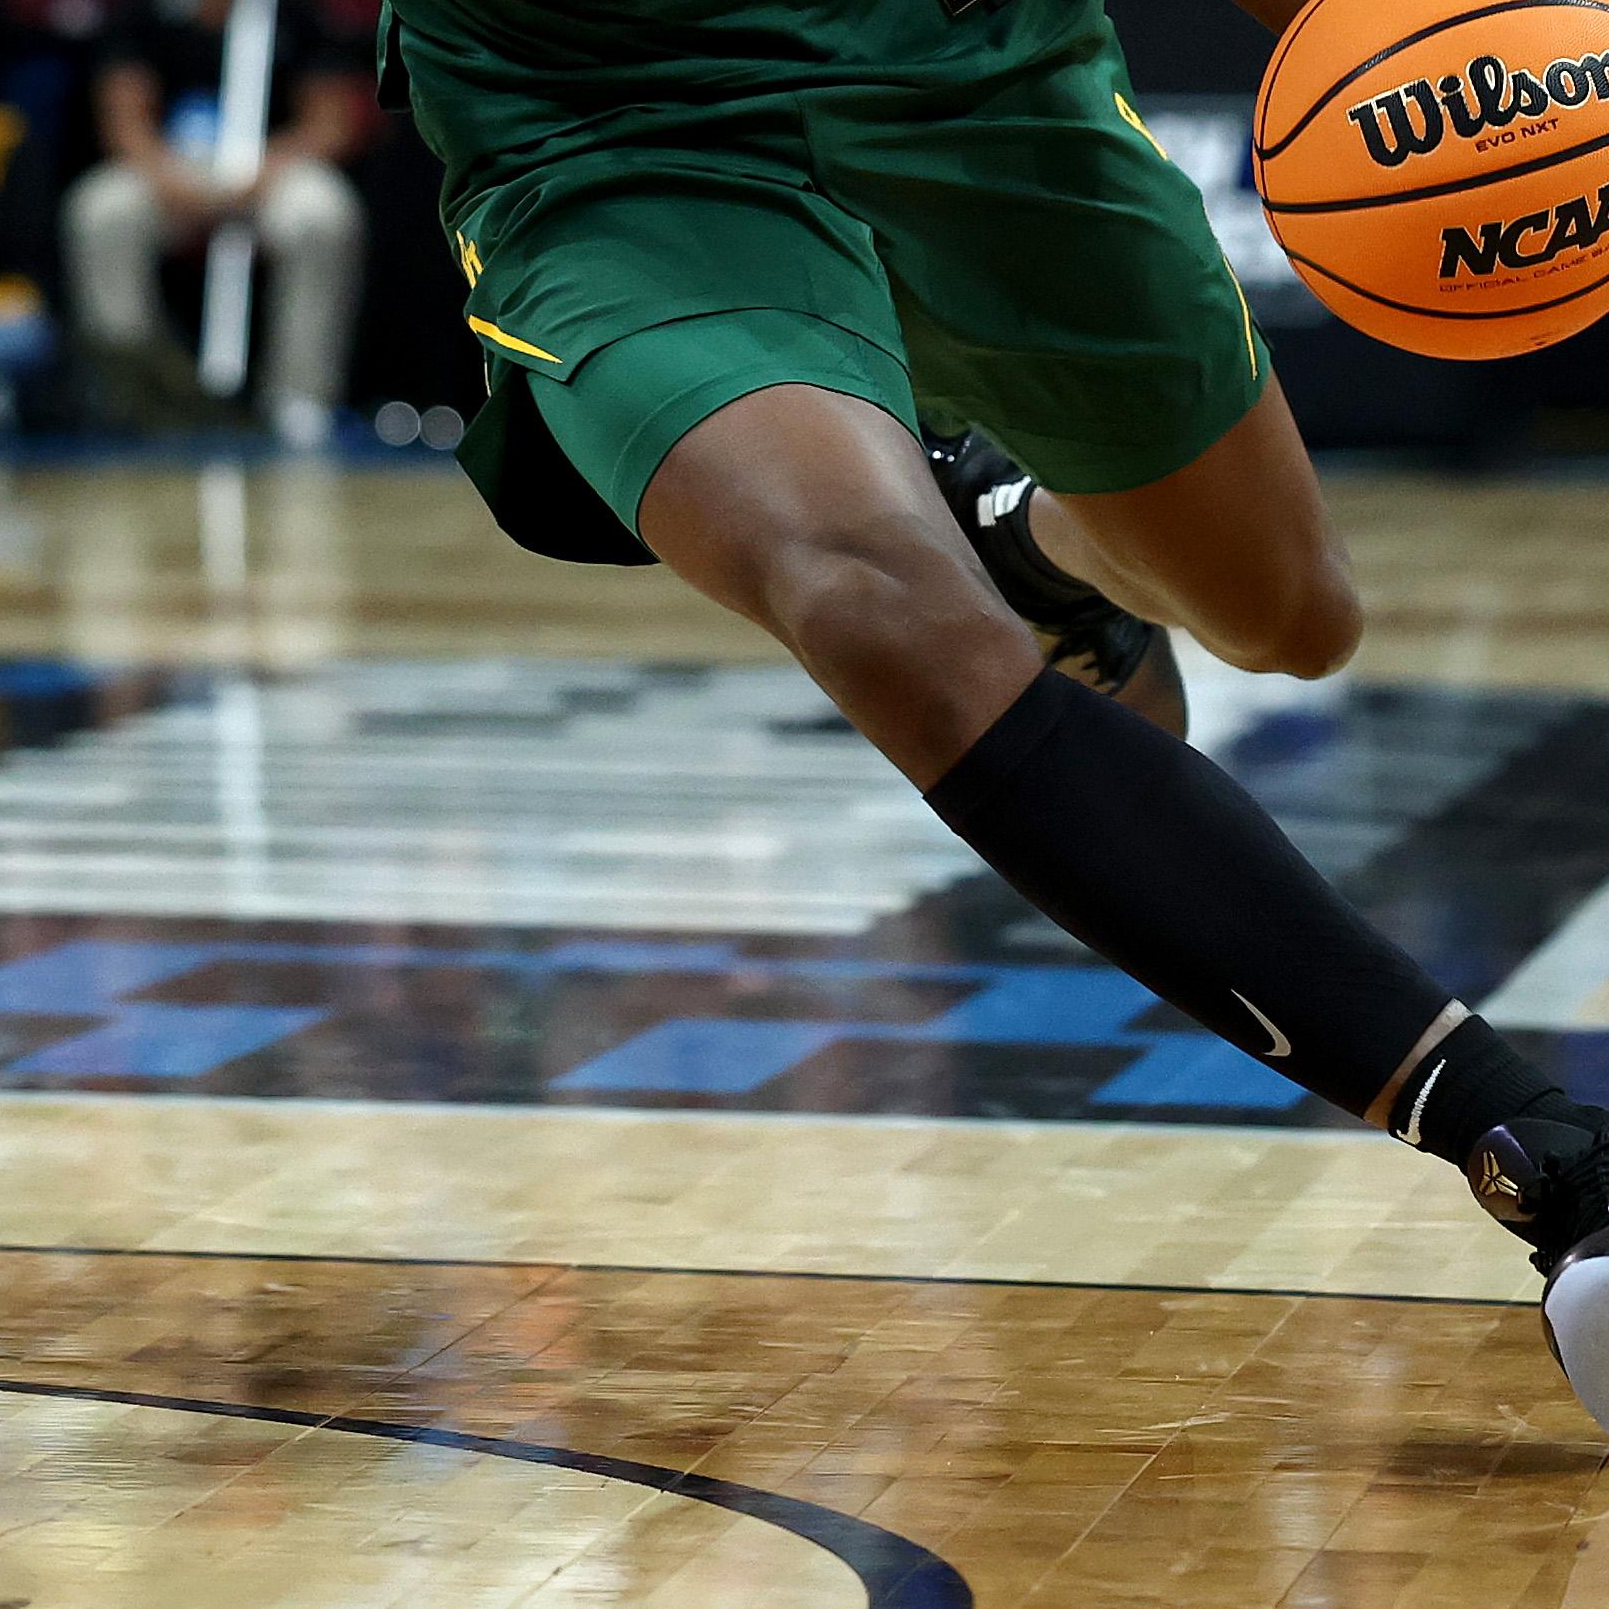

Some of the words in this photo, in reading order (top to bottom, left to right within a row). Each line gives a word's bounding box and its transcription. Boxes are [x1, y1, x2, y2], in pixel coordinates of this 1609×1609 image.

[1474, 131, 1517, 154] EVO
[1520, 117, 1559, 138] NXT
[1438, 274, 1528, 293] OFFICIAL
[1533, 252, 1587, 278] GAME
